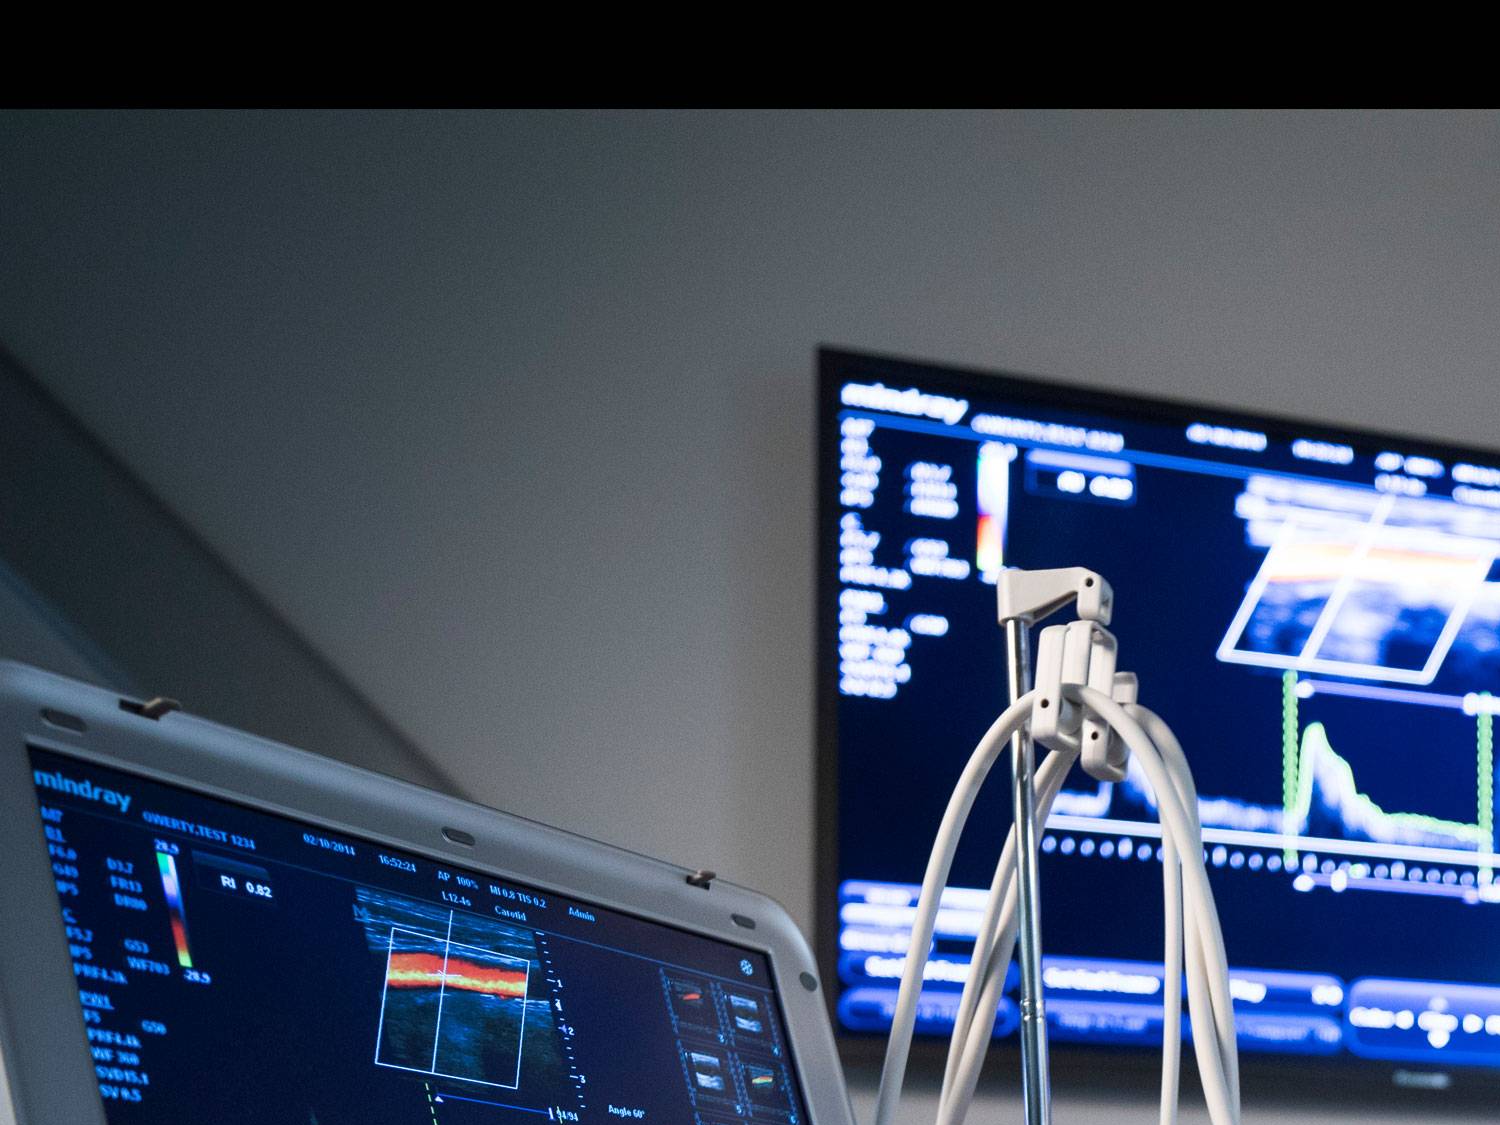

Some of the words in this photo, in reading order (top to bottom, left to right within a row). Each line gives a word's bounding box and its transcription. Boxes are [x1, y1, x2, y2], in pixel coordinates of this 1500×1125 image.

[34, 771, 131, 813] mindray
[231, 835, 256, 849] 1234
[438, 871, 450, 881] AP
[221, 875, 236, 889] RI
[246, 882, 272, 898] 0.82
[533, 897, 546, 908] 0.2
[495, 906, 526, 921] Carotid
[569, 907, 595, 922] Admin
[566, 1027, 574, 1035] 2
[577, 1075, 585, 1083] 3
[609, 1105, 631, 1117] Angle
